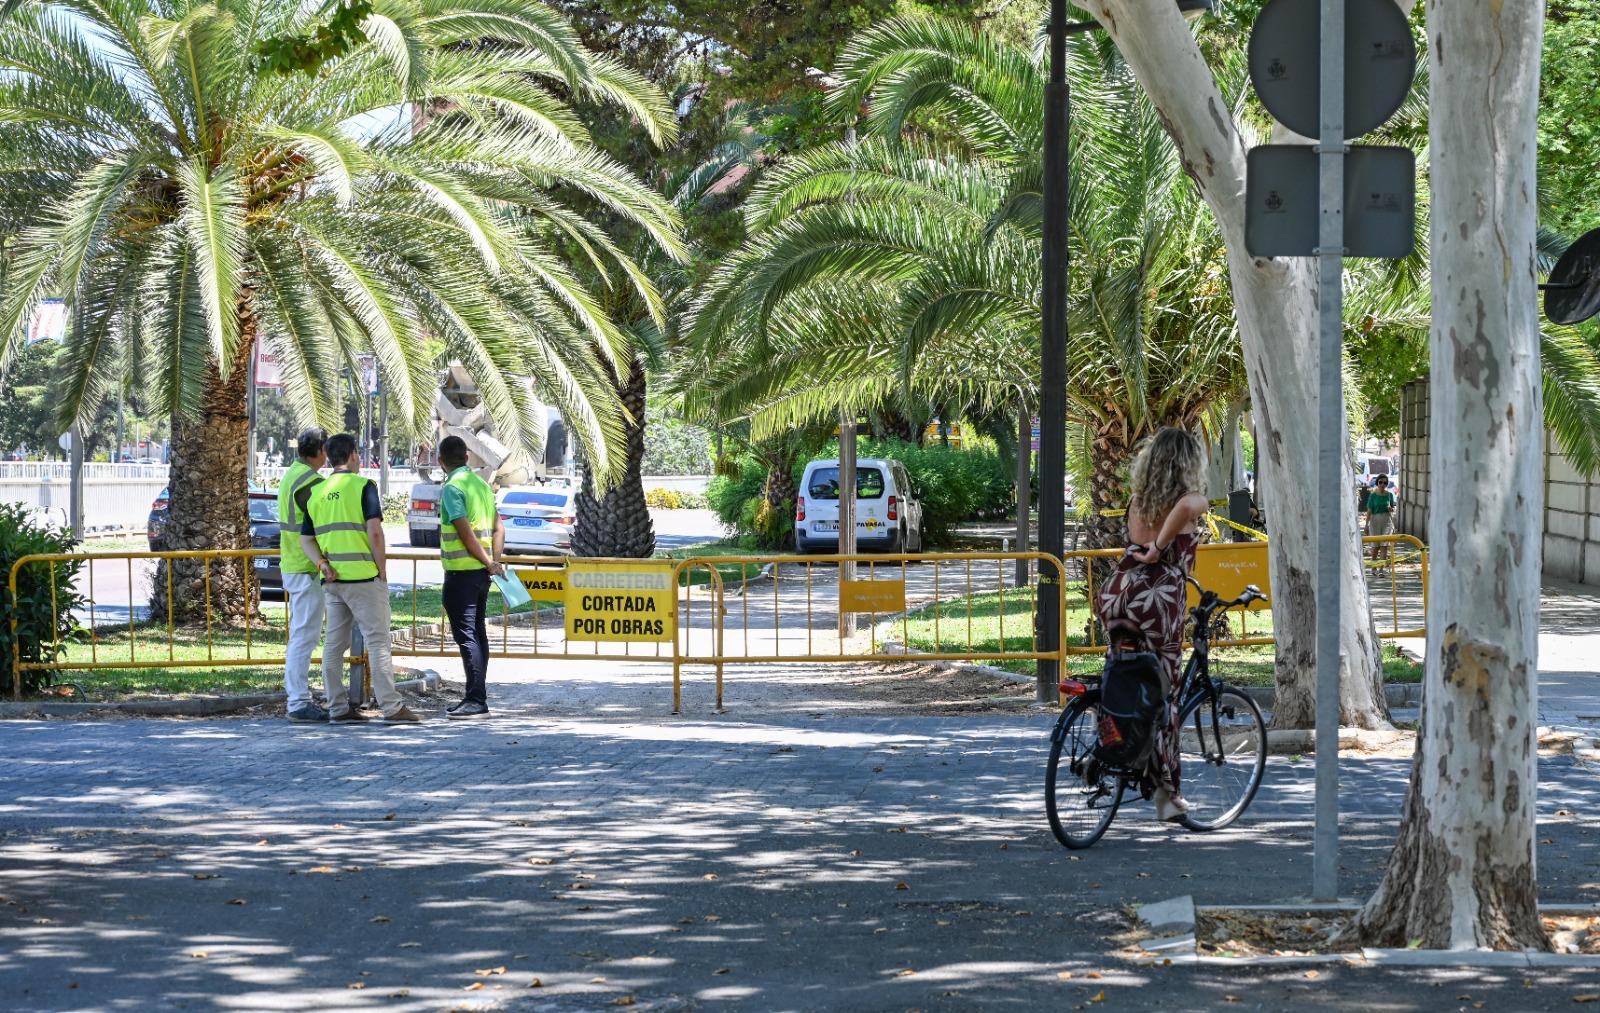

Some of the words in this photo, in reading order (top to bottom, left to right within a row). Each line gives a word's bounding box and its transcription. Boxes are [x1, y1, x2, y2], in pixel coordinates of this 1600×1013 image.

[327, 491, 340, 501] CPS
[523, 580, 563, 591] VASAL
[572, 572, 665, 589] CARRETERA
[582, 595, 656, 612] CORTADA
[573, 618, 606, 635] POR
[611, 619, 664, 635] OBRAS
